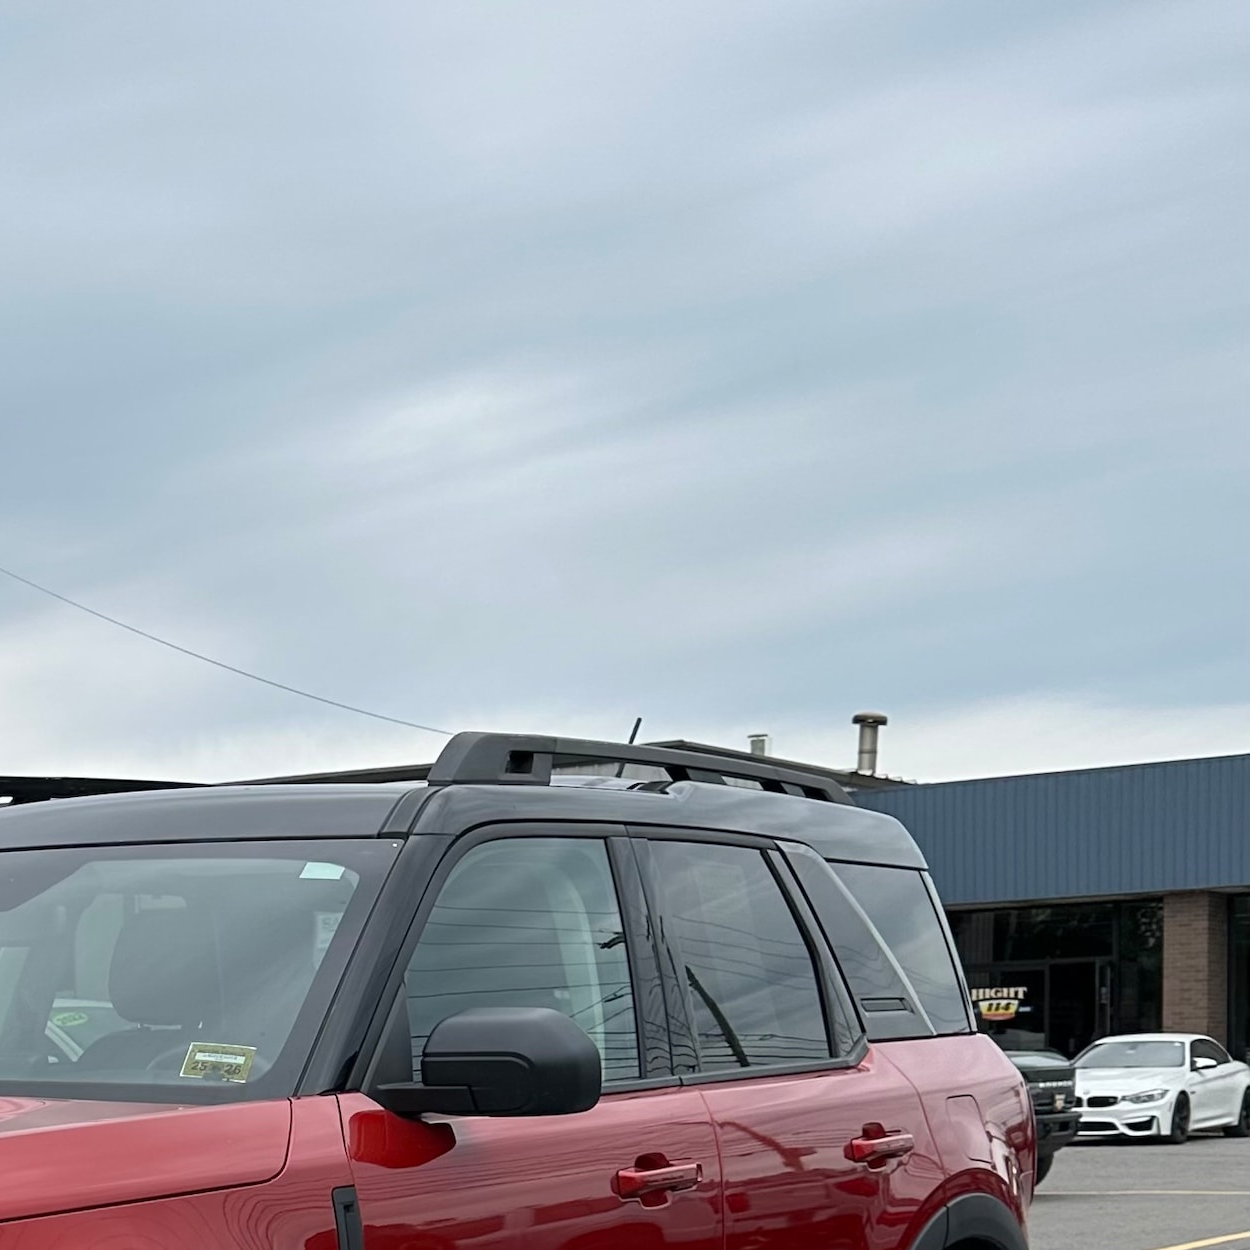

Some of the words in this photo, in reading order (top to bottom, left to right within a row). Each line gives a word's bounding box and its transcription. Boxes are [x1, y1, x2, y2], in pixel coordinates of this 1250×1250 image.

[971, 986, 1028, 1001] HIGHT
[191, 1061, 208, 1071] 25
[224, 1064, 241, 1076] 26
